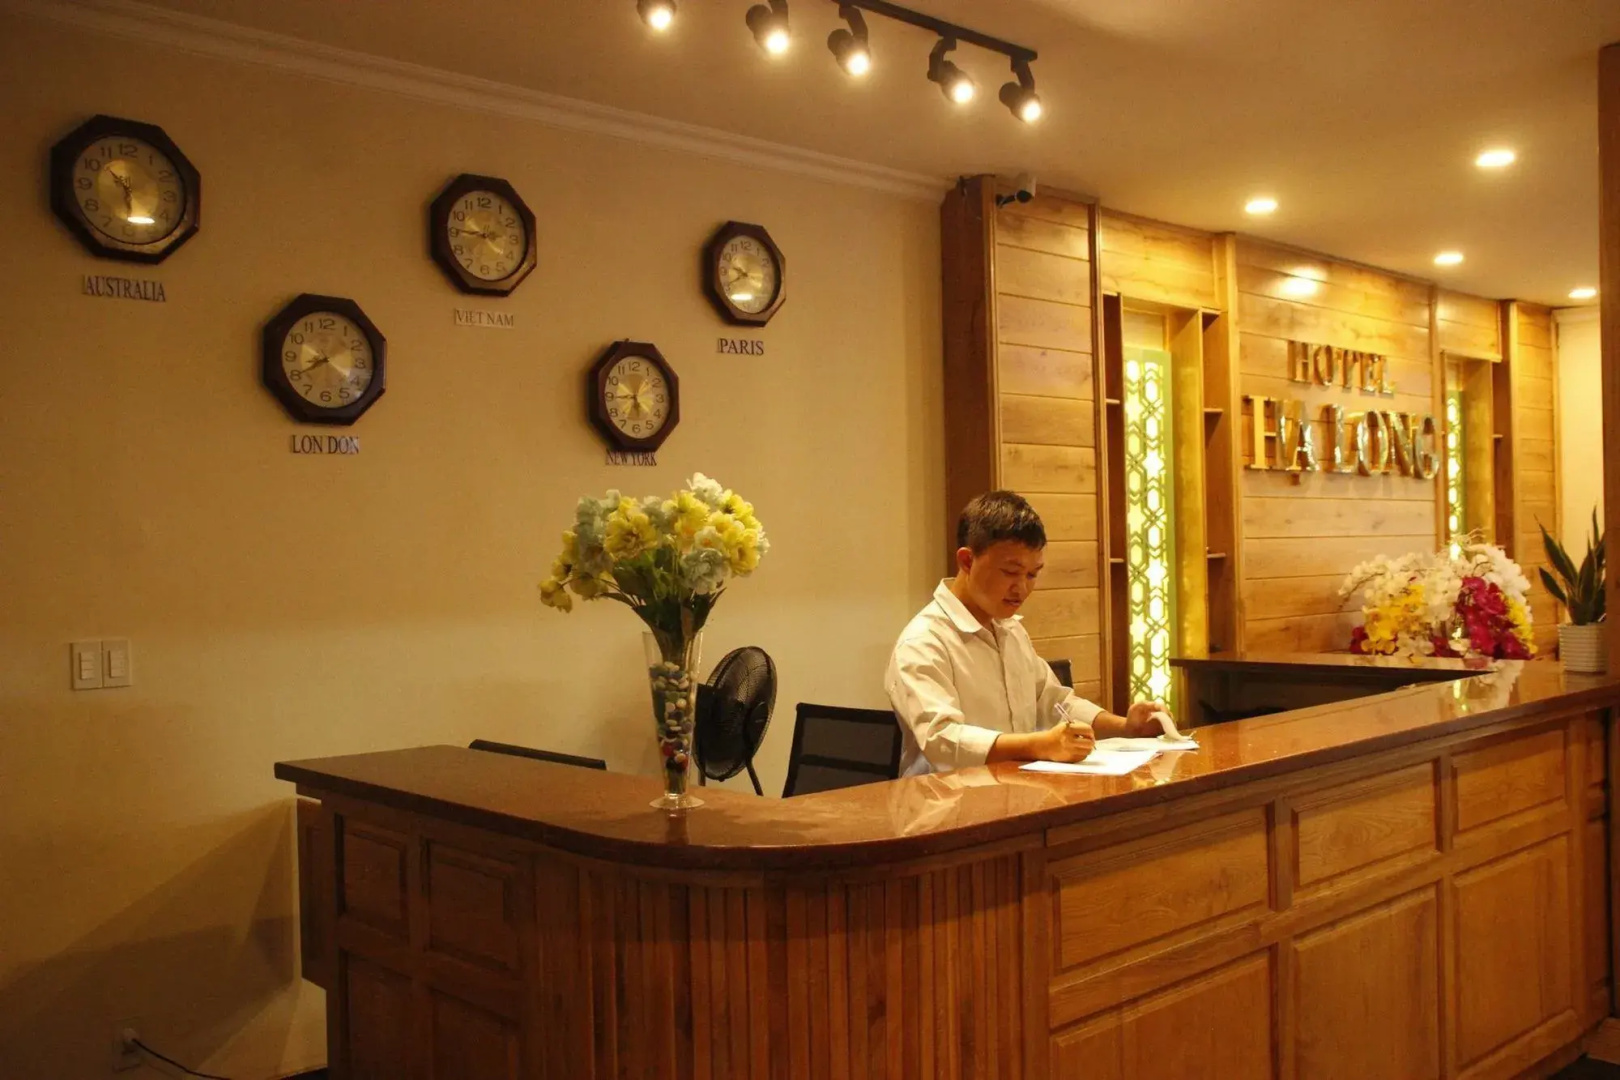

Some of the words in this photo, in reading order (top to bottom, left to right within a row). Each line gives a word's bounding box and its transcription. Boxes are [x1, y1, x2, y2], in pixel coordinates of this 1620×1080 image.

[101, 147, 112, 159] 11
[118, 143, 138, 158] 12
[84, 157, 100, 172] 10
[158, 170, 173, 183] 2
[78, 177, 93, 190] 9
[163, 190, 177, 203] 3
[84, 199, 99, 211] 8
[465, 199, 473, 211] 11
[477, 197, 492, 209] 12
[101, 216, 112, 228] 7
[159, 211, 169, 222] 4
[453, 210, 465, 222] 10
[505, 217, 516, 228] 2
[449, 226, 460, 238] 9
[509, 234, 519, 245] 3
[740, 240, 752, 251] 12
[454, 244, 464, 256] 8
[731, 243, 738, 253] 11
[506, 250, 514, 260] 4
[465, 258, 473, 269] 7
[480, 264, 490, 275] 6
[496, 261, 505, 272] 5
[86, 275, 166, 302] AUSTRALIA
[304, 321, 313, 333] 11
[318, 318, 336, 330] 12
[289, 332, 304, 345] 10
[351, 340, 362, 351] 2
[719, 338, 764, 356] PARIS
[285, 350, 297, 362] 9
[355, 358, 366, 369] 3
[628, 361, 640, 372] 12
[1287, 339, 1396, 394] HOTEL
[290, 369, 301, 381] 8
[617, 365, 625, 375] 11
[350, 375, 360, 387] 4
[607, 375, 619, 386] 10
[652, 377, 661, 388] 2
[303, 384, 313, 396] 7
[320, 390, 332, 402] 6
[338, 387, 350, 399] 5
[605, 392, 614, 402] 9
[655, 394, 664, 403] 3
[609, 407, 619, 418] 8
[653, 409, 661, 419] 4
[619, 419, 627, 429] 7
[632, 423, 641, 434] 6
[646, 420, 654, 430] 5
[1241, 395, 1320, 471] HA
[1321, 402, 1440, 480] LONG
[291, 434, 359, 454] LONDON
